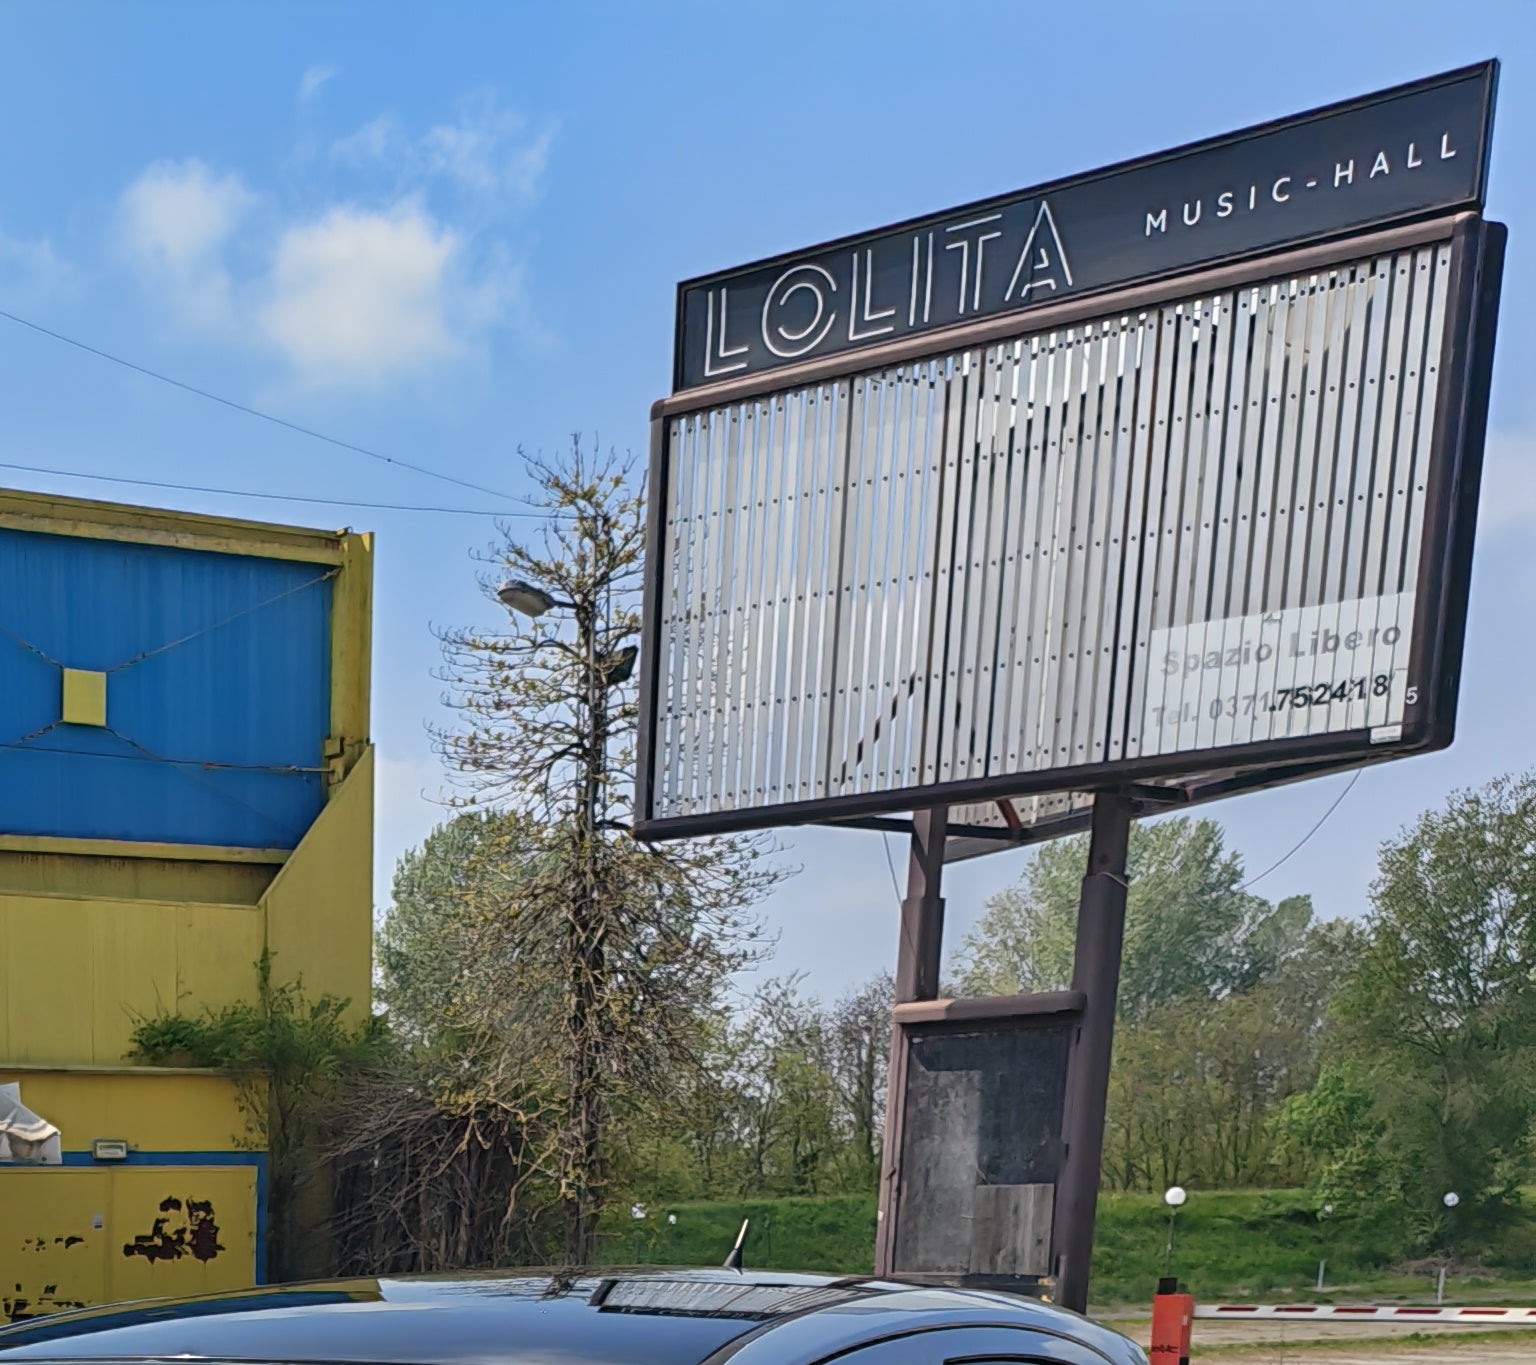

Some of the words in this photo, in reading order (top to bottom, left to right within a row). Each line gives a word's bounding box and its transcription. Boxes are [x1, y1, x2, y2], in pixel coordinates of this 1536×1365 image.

[704, 200, 1073, 378] LOLITA
[1144, 131, 1457, 238] MUSIC-HALL
[1160, 641, 1273, 679] Spazio
[1287, 624, 1402, 659] Libero
[1151, 703, 1197, 728] Tel.
